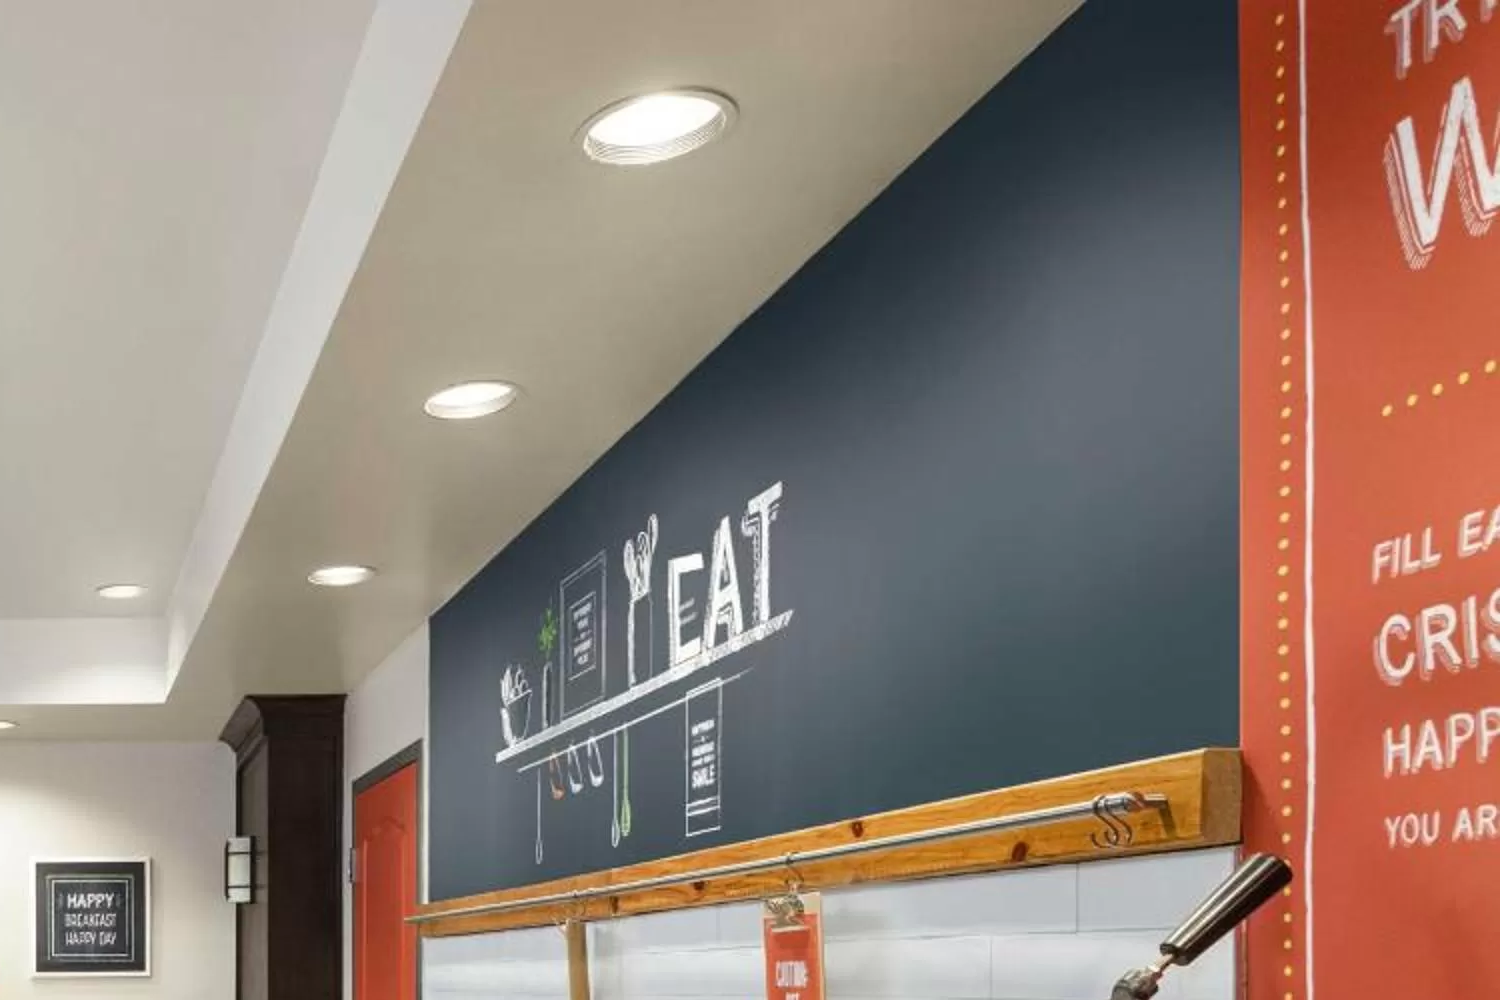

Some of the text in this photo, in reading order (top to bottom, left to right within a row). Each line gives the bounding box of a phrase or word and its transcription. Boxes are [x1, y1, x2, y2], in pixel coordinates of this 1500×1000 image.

[1386, 0, 1493, 76] TR
[667, 480, 784, 668] EAT
[1372, 527, 1442, 585] FILL
[1382, 706, 1500, 779] HAPP
[1384, 810, 1440, 848] YOU
[67, 892, 115, 909] HAPPY
[65, 931, 97, 946] HAPPY
